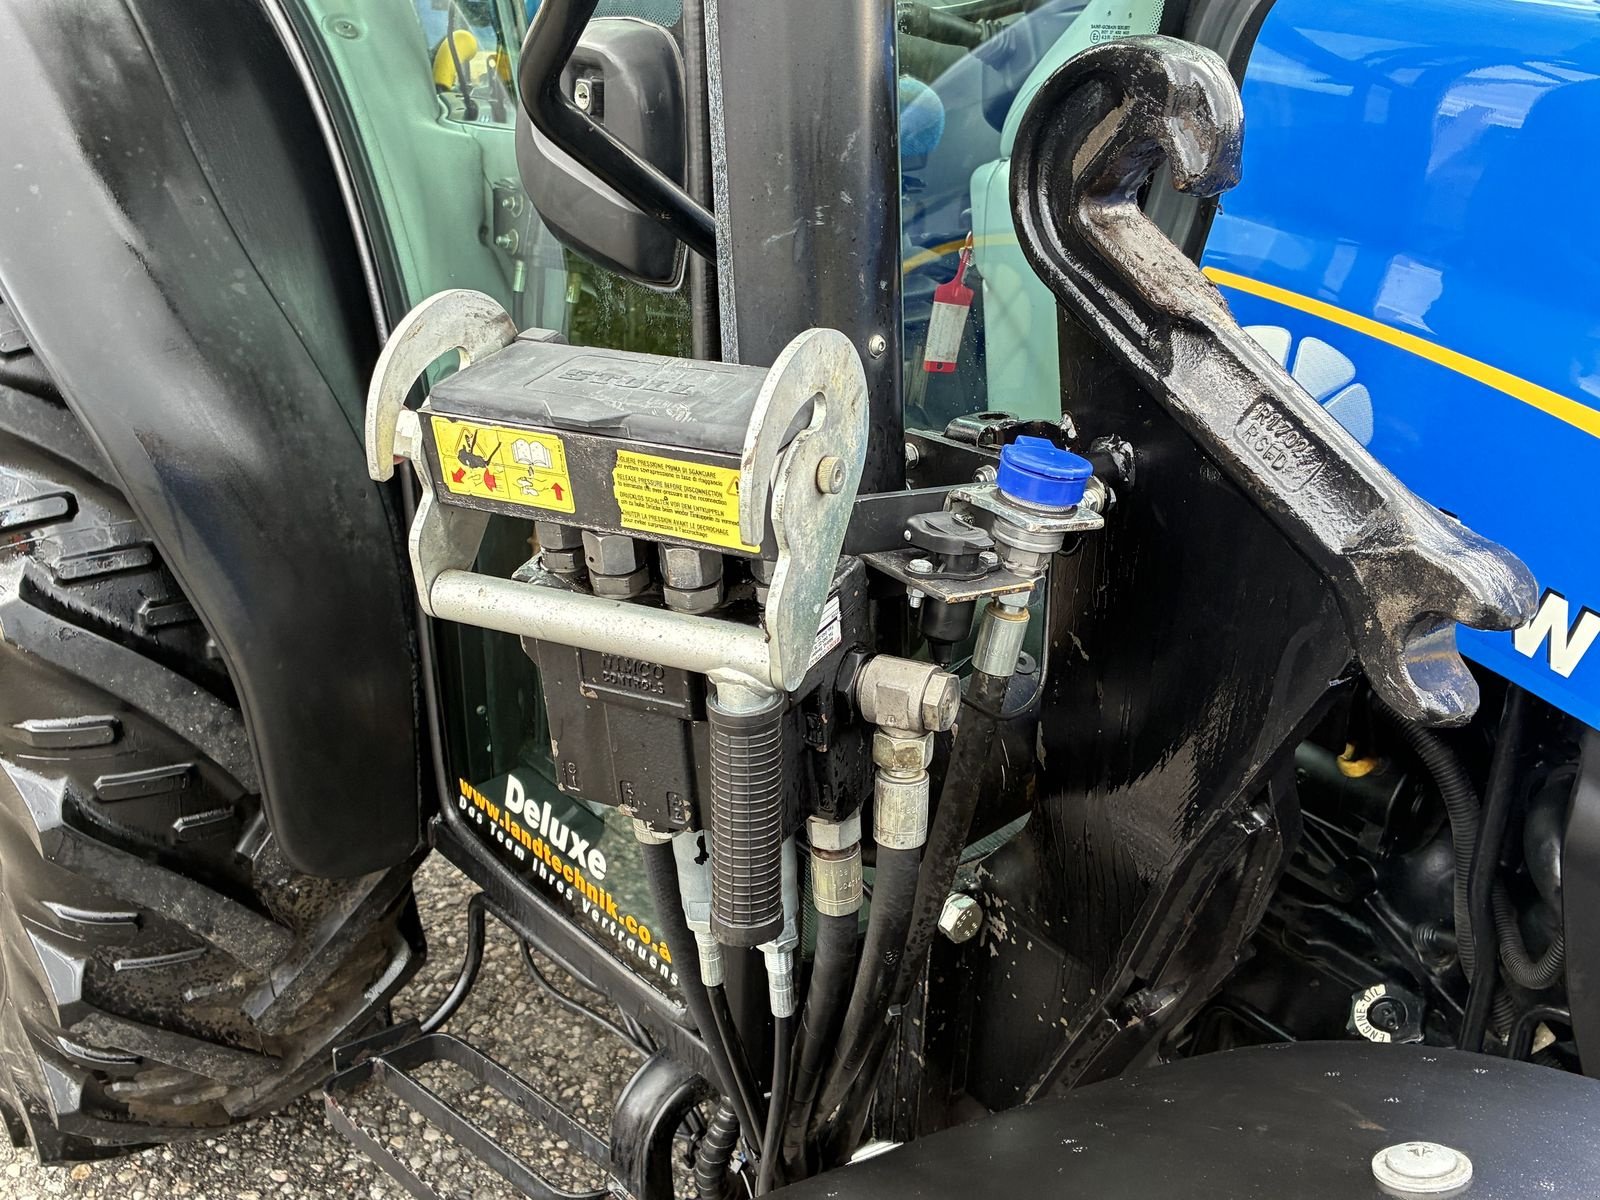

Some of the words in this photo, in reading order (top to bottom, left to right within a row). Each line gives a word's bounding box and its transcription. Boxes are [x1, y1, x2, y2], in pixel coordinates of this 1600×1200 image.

[617, 473, 636, 482] RELEASE
[638, 477, 662, 487] PRESSURE
[664, 481, 681, 490] BEFORE
[683, 485, 722, 498] DISCONNECTION
[602, 670, 666, 695] CONTROLS
[459, 778, 673, 964] www.landtechnik.co.a
[505, 774, 607, 880] Deluxe
[459, 795, 483, 825] Das
[490, 821, 525, 861] Team
[532, 858, 574, 901] Ihres
[582, 897, 679, 986] Vertrauens
